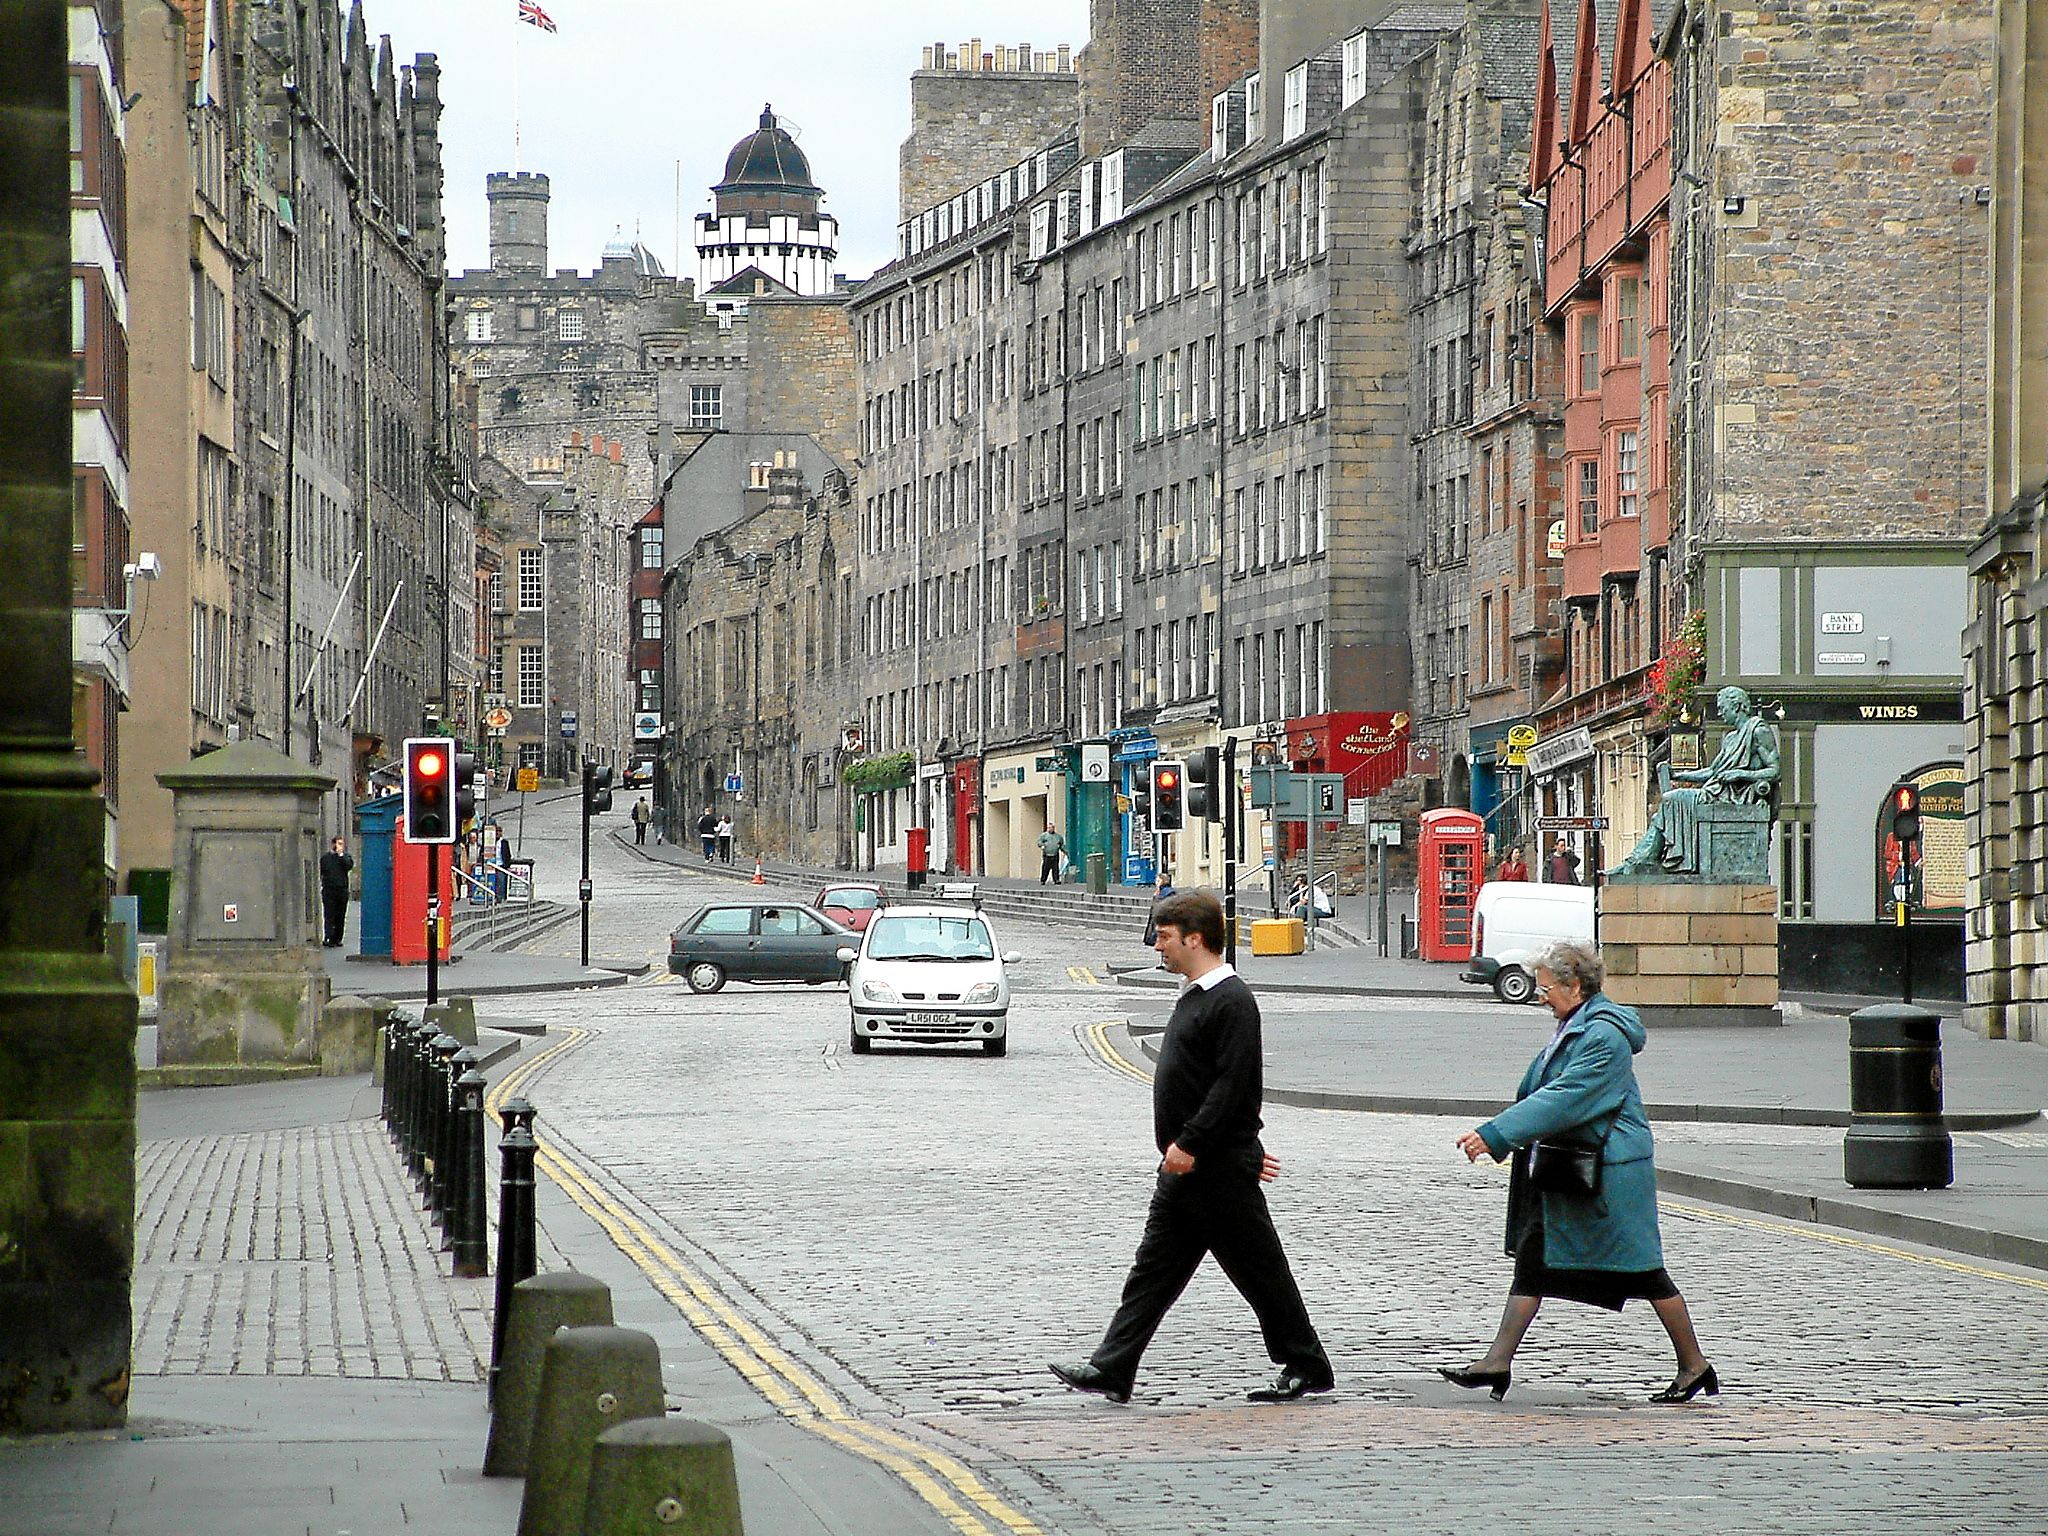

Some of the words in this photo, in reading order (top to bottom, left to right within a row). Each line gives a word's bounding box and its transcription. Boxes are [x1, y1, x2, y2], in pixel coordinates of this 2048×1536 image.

[1829, 614, 1855, 623] BANK
[1825, 623, 1858, 632] STREET
[1859, 705, 1918, 718] WINES
